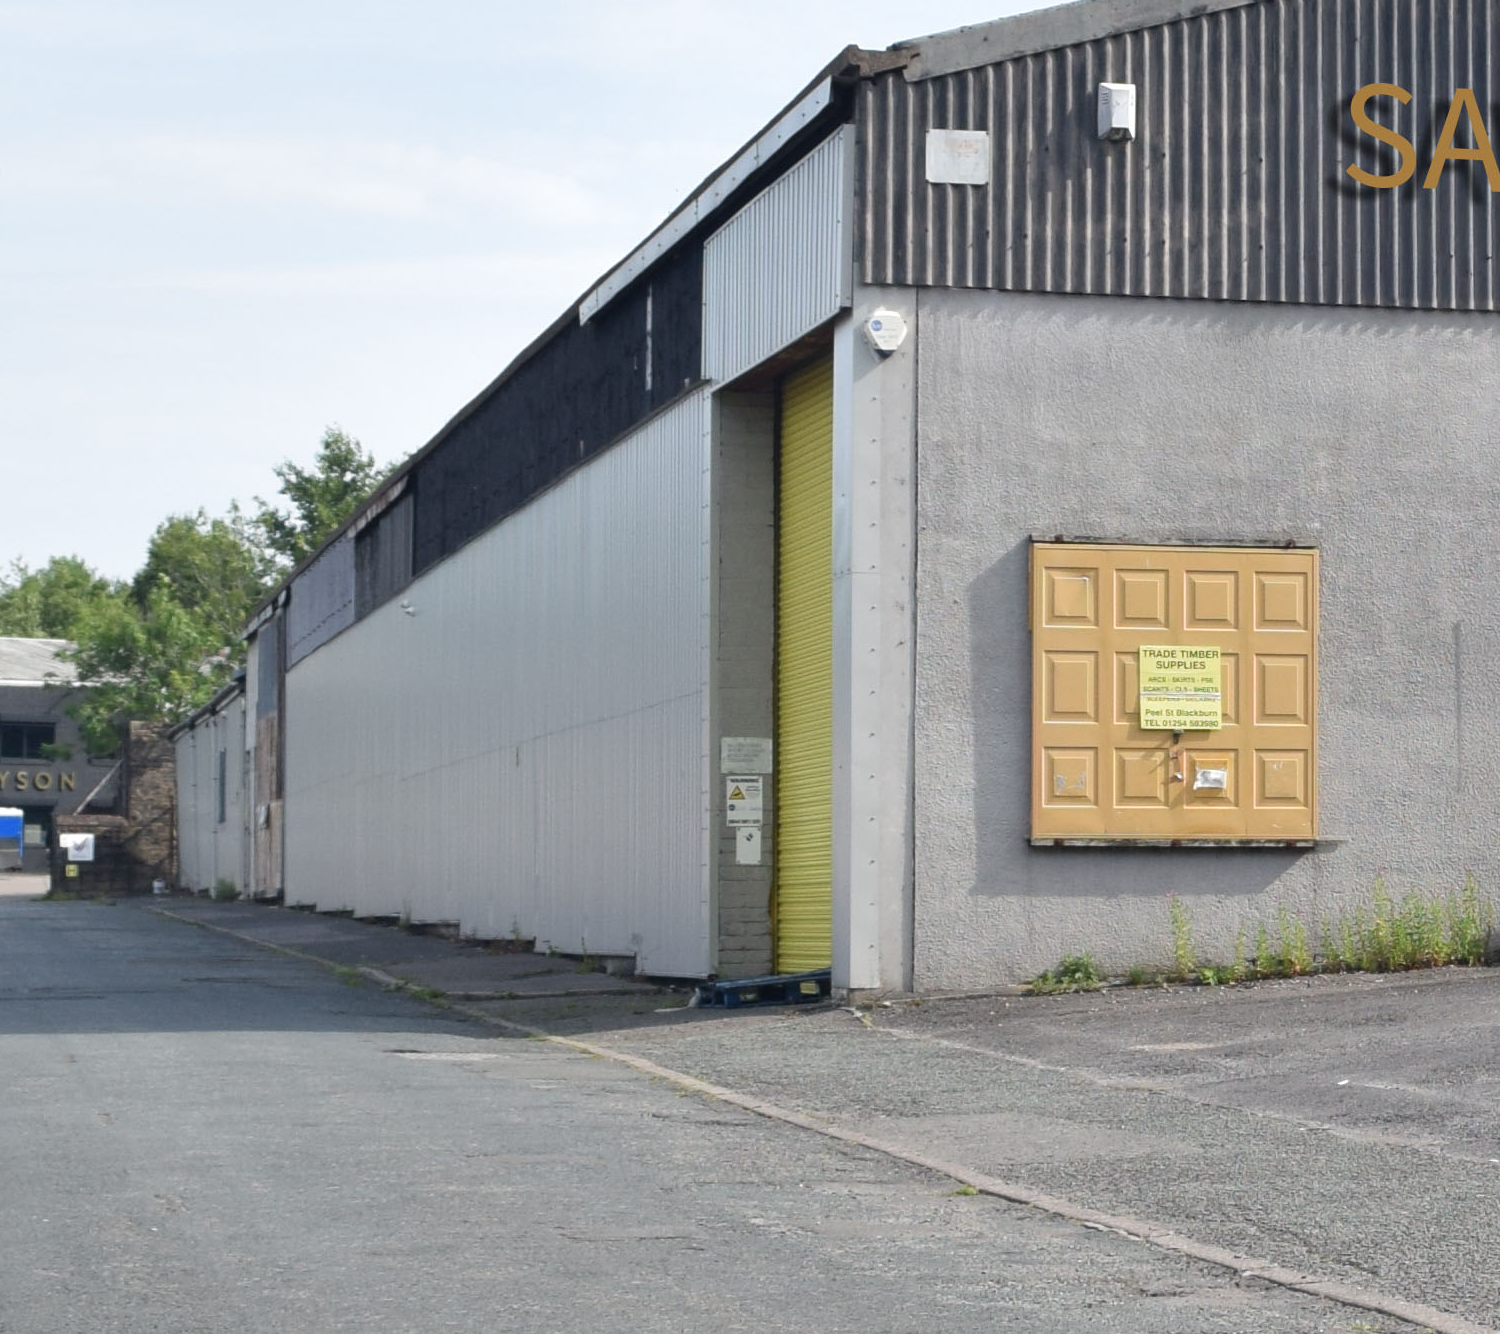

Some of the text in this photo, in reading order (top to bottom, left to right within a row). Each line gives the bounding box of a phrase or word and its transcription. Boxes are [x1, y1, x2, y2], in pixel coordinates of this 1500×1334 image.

[1142, 650, 1219, 658] TRADE TIMBER
[1156, 661, 1206, 669] SUPPLIES
[1176, 709, 1218, 717] Blackburn
